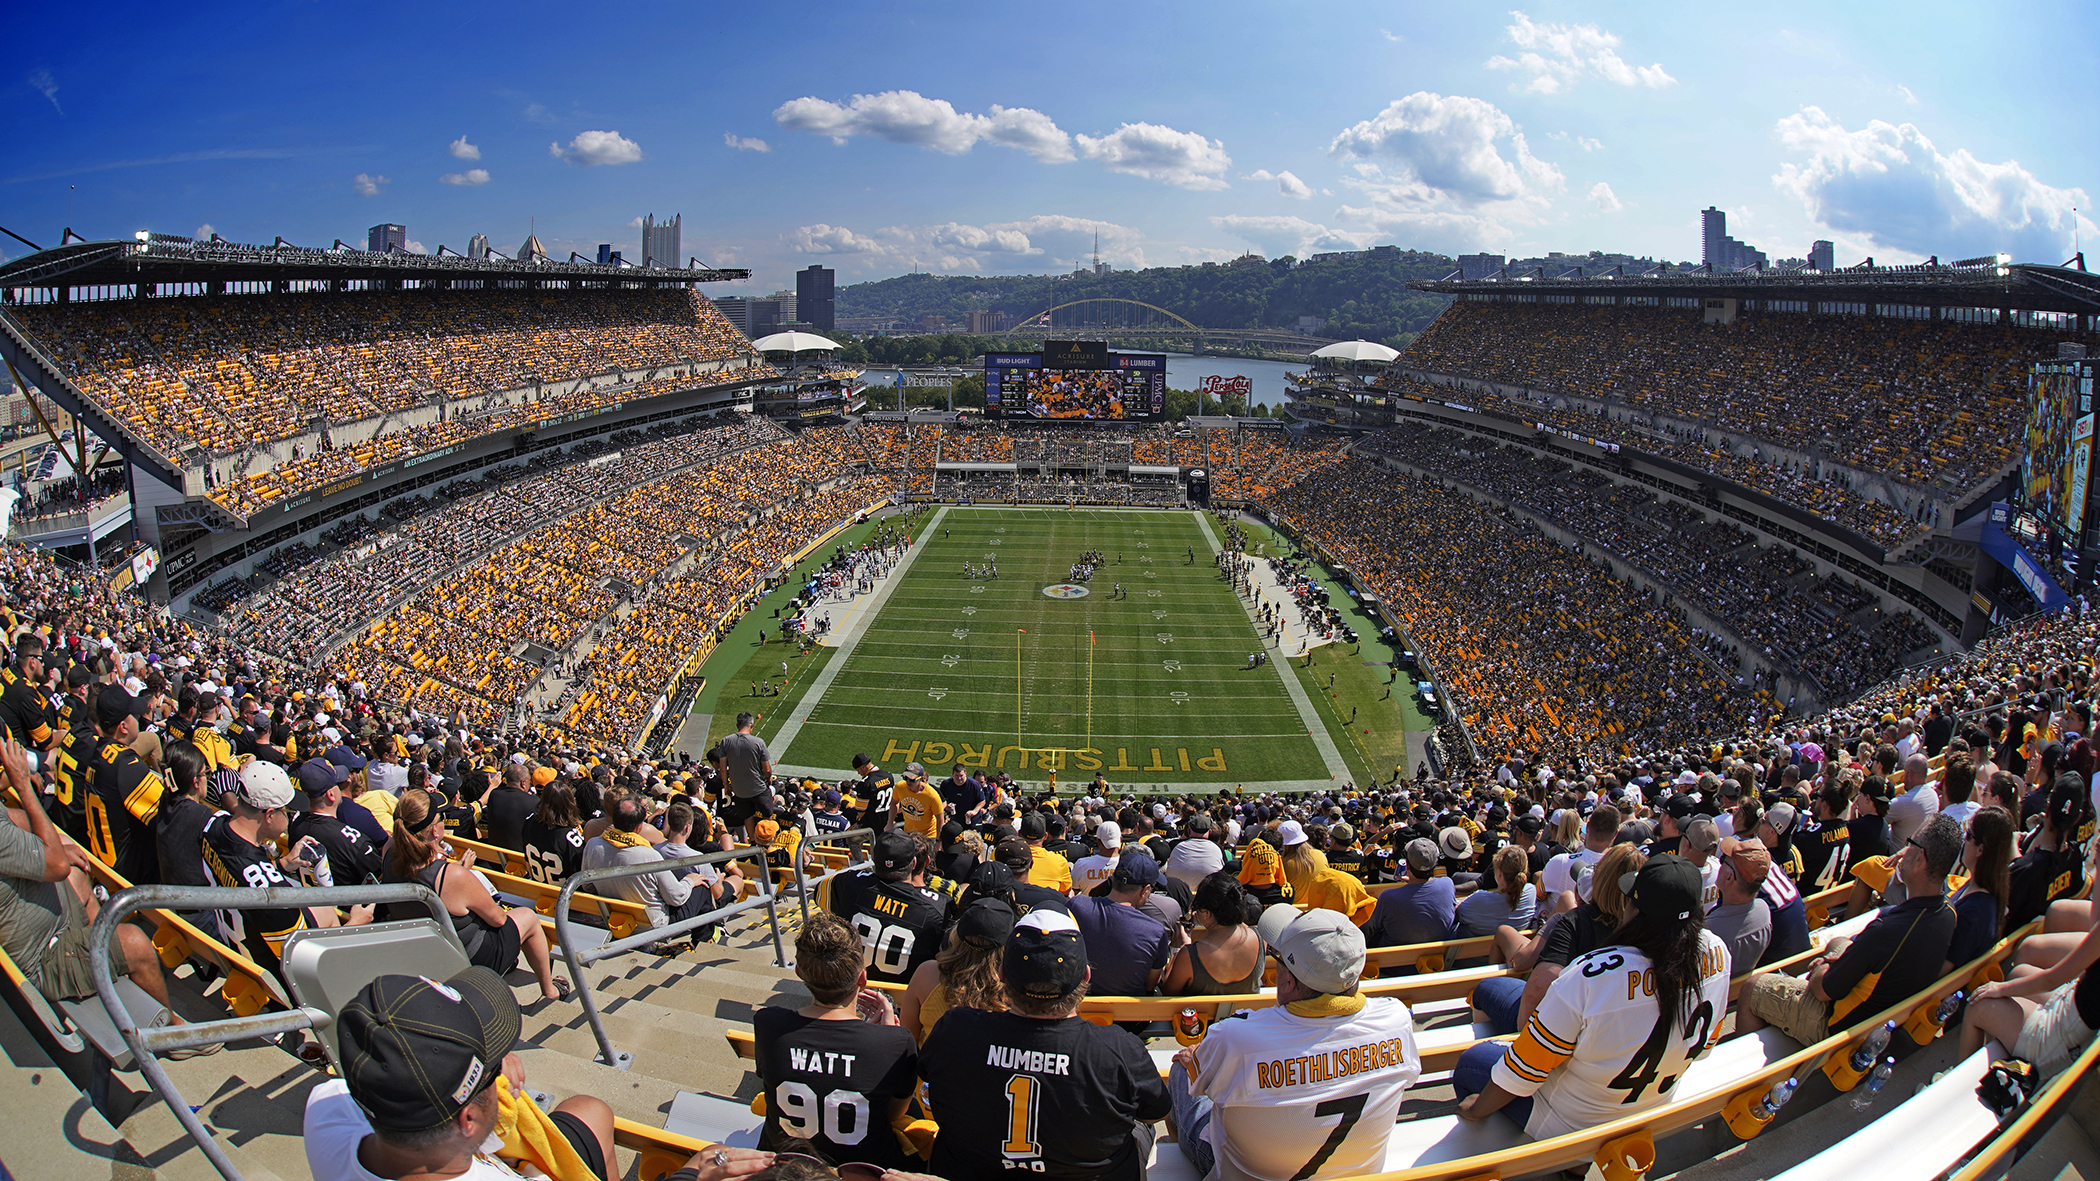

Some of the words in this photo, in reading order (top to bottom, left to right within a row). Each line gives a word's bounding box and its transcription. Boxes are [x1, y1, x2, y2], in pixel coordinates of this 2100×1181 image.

[906, 377, 952, 387] PEOPLES
[1154, 374, 1163, 402] UPMC
[377, 467, 395, 478] ACRISURE
[290, 496, 311, 508] ACRISURE
[322, 486, 338, 497] LEAVE
[338, 483, 345, 492] NO
[345, 476, 363, 490] DOUBT.
[166, 556, 186, 575] UPMC
[667, 628, 716, 702] PITTSBURGH
[880, 739, 1228, 772] PITTSBURGH
[54, 748, 78, 806] 5
[874, 778, 890, 789] HARRIS
[1066, 784, 1138, 793] TAES
[875, 788, 894, 814] 22
[84, 789, 118, 868] 0
[816, 817, 840, 829] EDELMAN
[243, 861, 284, 888] 88
[526, 843, 567, 886] 62
[1087, 868, 1115, 880] CLAYP
[1814, 843, 1850, 892] 43
[1761, 861, 1798, 910] 10
[874, 894, 908, 918] WATT
[851, 912, 915, 975] 90
[1628, 944, 1724, 1000] POALU
[1025, 992, 1061, 1000] STEELERS
[789, 1047, 856, 1078] WATT
[987, 1044, 1070, 1077] NUMBER
[1257, 1037, 1404, 1090] ROETHLISBERGER
[1608, 1000, 1714, 1105] 43
[467, 1063, 480, 1087] 1933
[776, 1081, 870, 1146] 90
[1001, 1073, 1043, 1160] 1
[1288, 1092, 1370, 1181] 7
